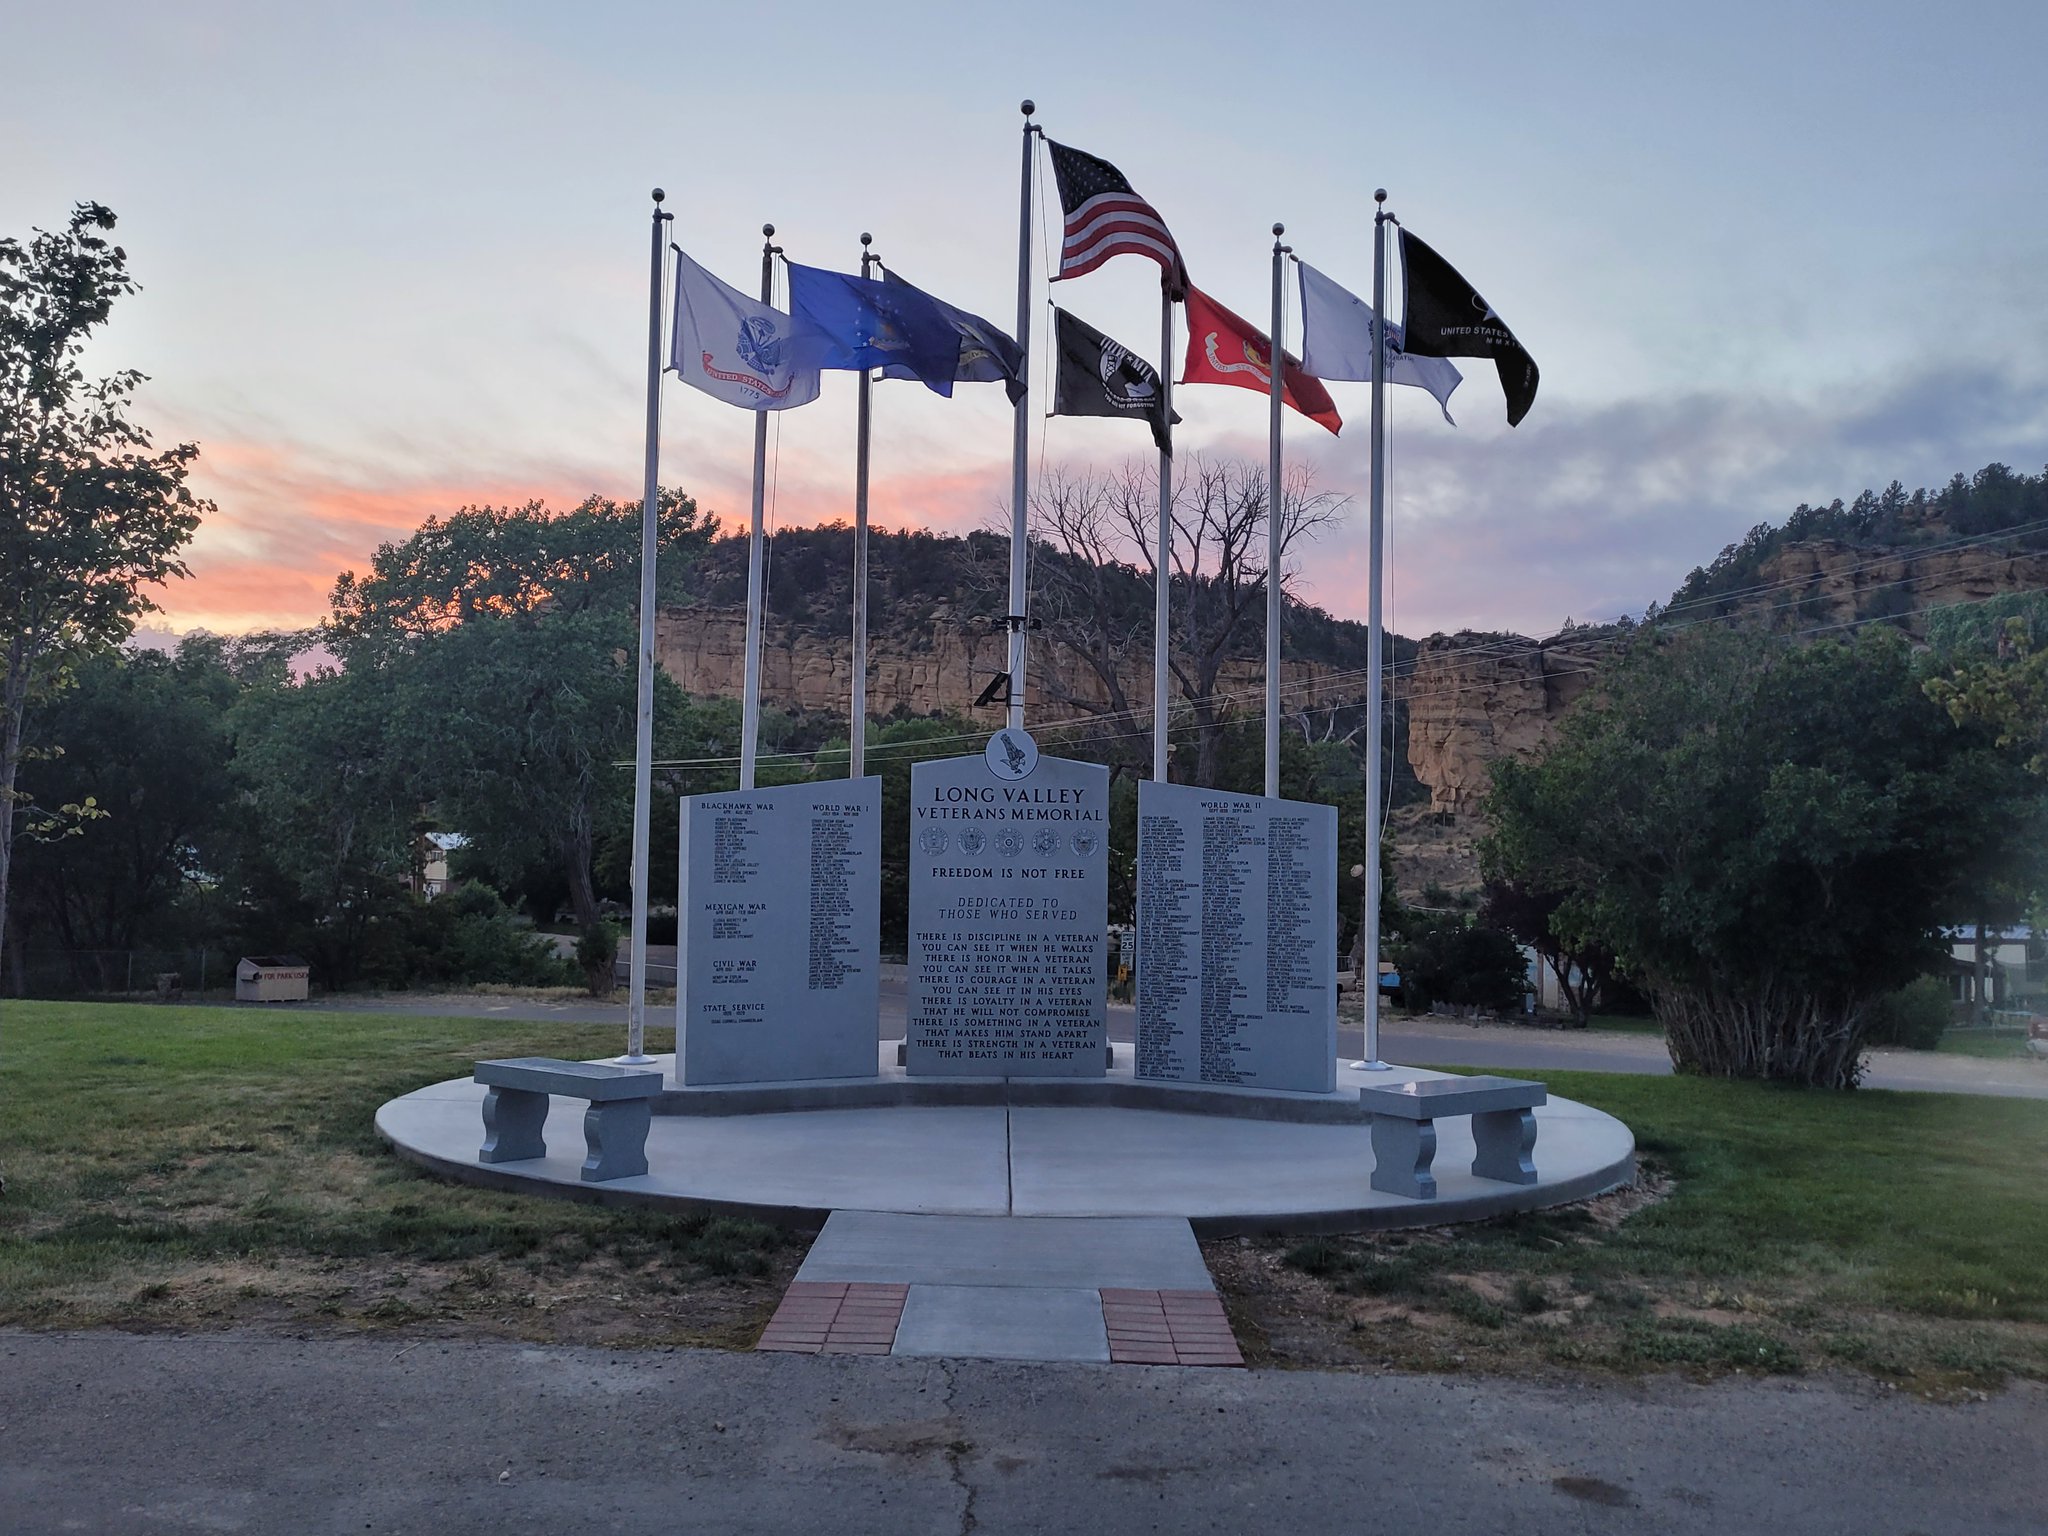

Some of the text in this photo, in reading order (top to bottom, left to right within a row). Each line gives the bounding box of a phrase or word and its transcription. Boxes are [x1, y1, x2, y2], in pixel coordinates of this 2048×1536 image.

[1441, 326, 1508, 338] UNITED STATES
[1209, 353, 1228, 371] UNITED
[1131, 357, 1153, 383] MIA
[707, 367, 772, 395] UNITED STATES
[739, 386, 760, 399] 1775
[935, 787, 1084, 804] LONG VALLEY
[701, 802, 752, 810] BLACKHAWK
[917, 807, 1103, 821] VETERANS MEMORIAL
[932, 868, 1085, 879] FREEDOM IS NOT FREE
[958, 897, 1058, 908] DEDICATED TO
[939, 909, 1077, 920] THOSE WHO SERVED
[953, 933, 962, 941] IS
[968, 933, 1021, 941] DISCIPLINE
[1027, 934, 1037, 942] IN
[1043, 934, 1049, 942] A
[1054, 934, 1099, 942] VETERAN
[922, 943, 941, 951] YOU
[973, 944, 990, 952] SEE
[996, 944, 1005, 952] IT
[1010, 944, 1038, 952] WHEN
[1061, 945, 1093, 953] WALKS
[925, 954, 1089, 963] THERE IS HONOR IN A VETERAN
[713, 960, 734, 968] CIVIL
[923, 965, 1092, 974] YOU CAN SEE IT WHEN HE TALKS
[955, 975, 964, 984] IS
[970, 976, 1017, 984] COURAGE
[1024, 976, 1033, 984] IN
[1051, 977, 1095, 985] VETERAN
[932, 986, 1082, 996] YOU CAN SEE IT IN HIS EYES
[921, 997, 952, 1005] THERE
[958, 997, 967, 1005] IS
[973, 997, 1015, 1005] LOYALTY
[1036, 998, 1043, 1006] A
[1048, 998, 1092, 1006] VETERAN
[732, 1003, 765, 1011] SERVICE
[923, 1007, 948, 1015] THAT
[971, 1008, 994, 1016] WILL
[999, 1008, 1019, 1016] NOT
[1024, 1008, 1090, 1017] COMPROMISE
[912, 1018, 943, 1026] THERE
[949, 1018, 958, 1026] IS
[964, 1018, 1022, 1027] SOMETHING
[1028, 1019, 1038, 1027] IN
[1056, 1019, 1100, 1028] VETERAN
[925, 1029, 1088, 1038] THAT MAKES HIM STAND APART
[953, 1040, 962, 1048] IS
[968, 1040, 1018, 1048] STRENGTH
[1052, 1041, 1096, 1049] VETERAN
[938, 1050, 1074, 1059] THAT BEATS IN HIS HEART
